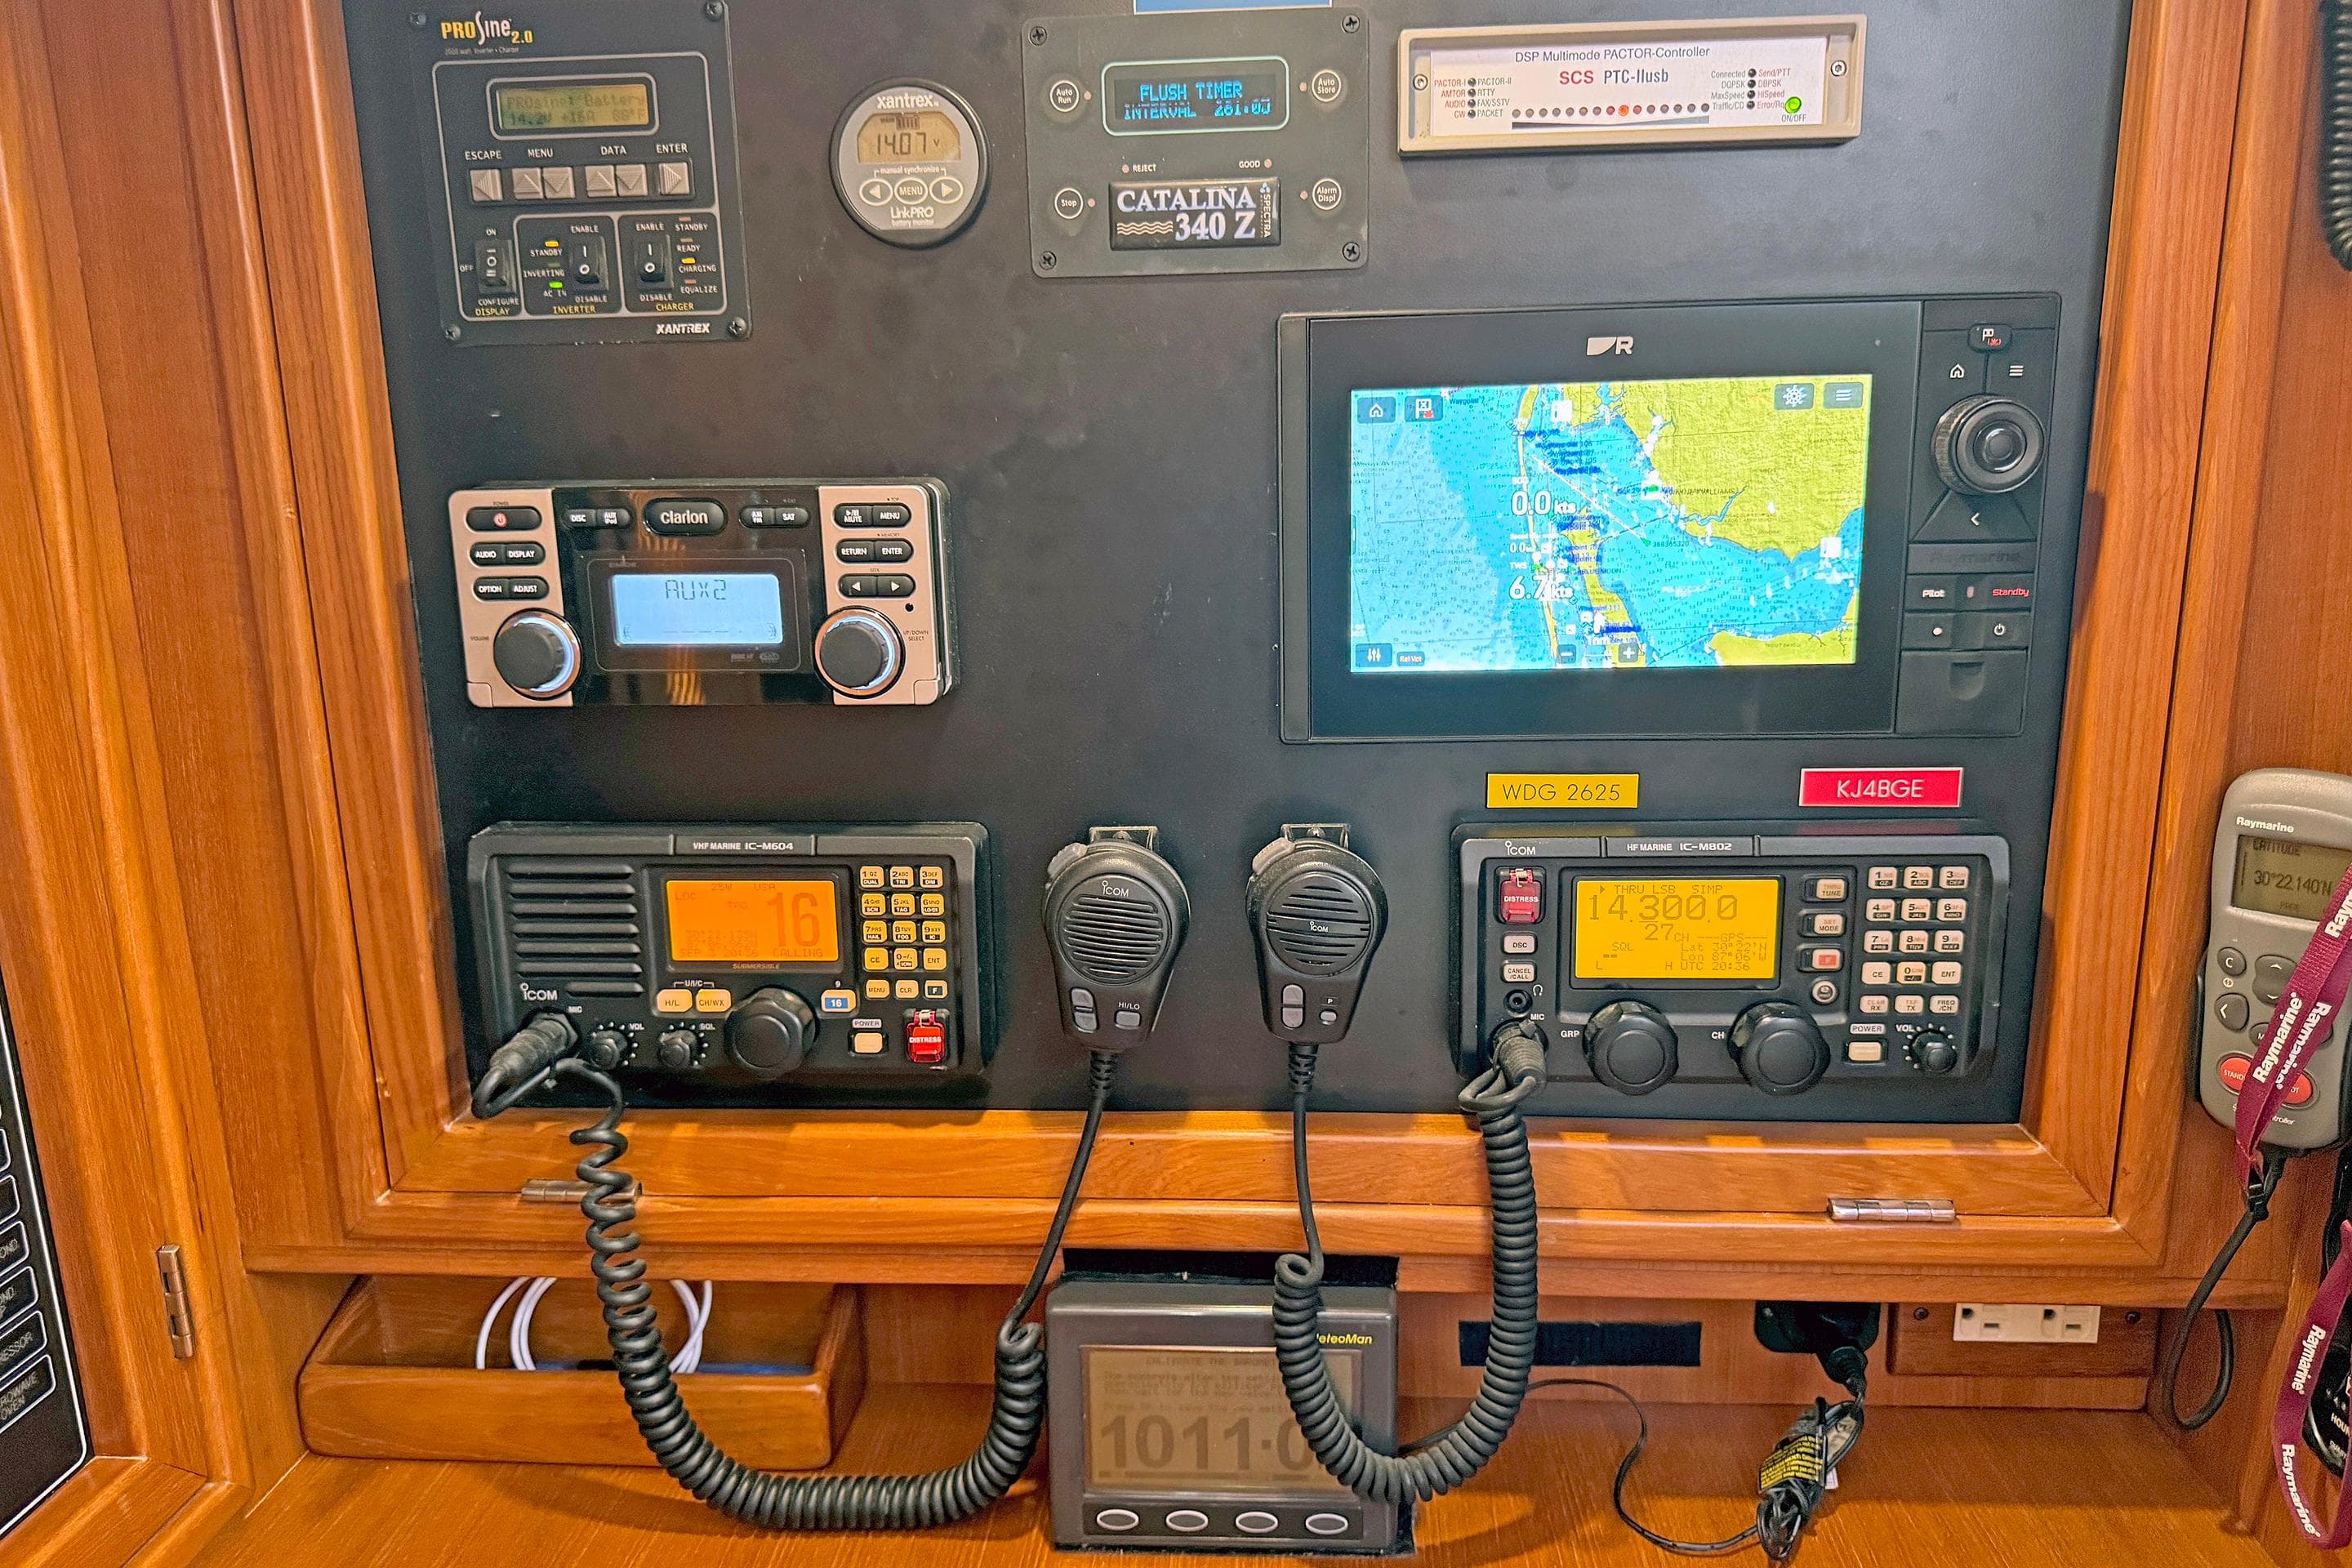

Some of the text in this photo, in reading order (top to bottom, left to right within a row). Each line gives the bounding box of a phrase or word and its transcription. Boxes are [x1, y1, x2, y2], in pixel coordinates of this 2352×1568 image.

[511, 29, 533, 43] 2.0
[1515, 46, 1710, 63] DSP Multimode PACTOR-Controller
[1559, 69, 1595, 85] SCS
[1711, 70, 1746, 78] Connected
[1758, 68, 1791, 77] Send/PTT
[1317, 78, 1335, 87] Auto
[1056, 88, 1073, 96] Auto
[1140, 81, 1243, 101] FLUSH TIMER
[1317, 85, 1335, 95] Store
[1441, 89, 1466, 98] AMTOR
[1477, 88, 1495, 96] RTTY
[1058, 96, 1072, 105] Run
[1711, 91, 1745, 101] MaxSpeed
[877, 93, 934, 109] xantrex
[1445, 100, 1466, 109] AUDIO
[1477, 98, 1510, 107] FAX/SSTV
[1124, 101, 1197, 120] INTERVAL
[1454, 110, 1466, 118] CW
[1477, 109, 1503, 118] PACKET
[1781, 114, 1806, 122] ON/OFF
[877, 131, 927, 155] 14.07
[528, 149, 554, 158] MENU
[600, 145, 627, 156] DATA
[656, 144, 688, 154] ENTER
[465, 150, 502, 161] ESCAPE
[1132, 164, 1157, 173] REJECT
[1238, 160, 1261, 169] GOOD
[880, 166, 902, 174] manual
[899, 186, 923, 196] MENU
[1316, 186, 1338, 194] Alarm
[1061, 198, 1077, 208] Stop
[1116, 186, 1256, 213] CATALINA
[1317, 194, 1337, 203] Displ
[890, 206, 935, 219] LinkPRO
[1263, 194, 1271, 238] SPECTRA
[571, 225, 599, 234] ENABLE
[635, 223, 665, 232] ENABLE
[675, 223, 708, 232] STANDBY
[1174, 211, 1256, 241] 340 Z
[530, 248, 563, 257] STANDBY
[677, 244, 701, 253] READY
[460, 264, 474, 273] OFF
[679, 265, 717, 274] CHARGING
[523, 269, 565, 278] INVERTING
[543, 290, 554, 298] AC
[680, 285, 718, 294] EQUALIZE
[478, 297, 519, 306] CONFIGURE
[575, 295, 608, 304] DISABLE
[639, 293, 673, 302] DISABLE
[553, 305, 596, 314] INVERTER
[656, 302, 694, 312] CHARGER
[475, 308, 510, 316] DISPLAY
[656, 323, 710, 336] XANTREX
[1512, 491, 1577, 516] 0.0 kts
[782, 513, 795, 521] SAT
[844, 515, 862, 523] MUTE
[880, 511, 901, 520] MENU
[475, 550, 497, 559] AUDIO
[508, 550, 535, 559] DISPLAY
[841, 547, 867, 555] RETURN
[881, 547, 903, 555] ENTER
[479, 585, 502, 594] OPTION
[513, 585, 537, 593] ADJUST
[1922, 589, 1945, 598] Pilot
[1992, 588, 2029, 598] Standby
[1503, 783, 1621, 801] WDG 2625
[1836, 779, 1924, 799] KJ4BGE
[2236, 816, 2295, 833] Raymarine
[693, 842, 794, 850] VHF MARINE IC-M604
[1640, 843, 1673, 851] MARINE
[1680, 842, 1732, 851] IC-M802
[2253, 839, 2301, 856] LATITUDE
[1614, 884, 1723, 894] THRU LSB SIMP
[767, 892, 820, 947] 16
[1645, 924, 1690, 942] 27 CH
[1612, 942, 1633, 951] SQL
[773, 949, 823, 957] CALLING
[1665, 961, 1750, 971] H UTC 20:36
[2225, 957, 2234, 968] C
[699, 999, 724, 1007] CH/WX
[831, 999, 842, 1007] 16
[1896, 1024, 1914, 1032] VOL
[1561, 1030, 1580, 1038] GRP
[2252, 997, 2303, 1083] Raymarine
[1317, 1334, 1373, 1345] eteoMan
[2292, 1324, 2327, 1393] Raymarine
[2282, 1443, 2318, 1537] Raymarine
